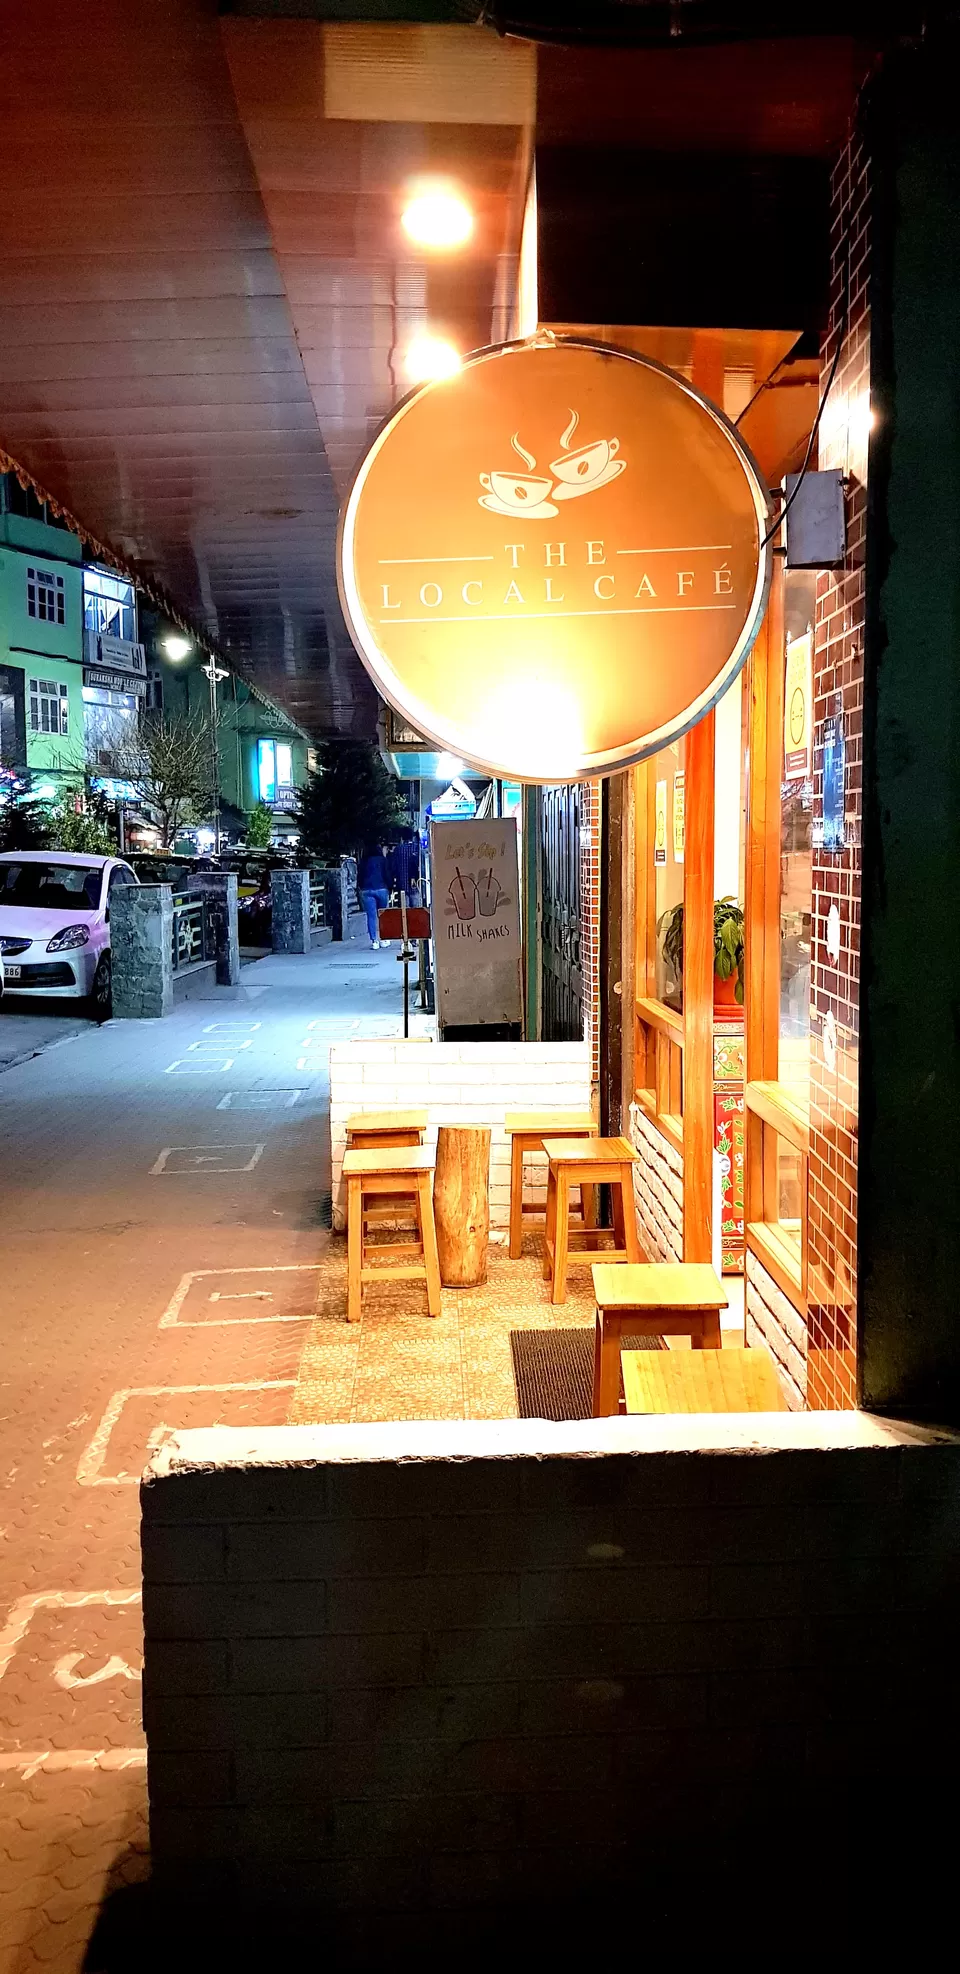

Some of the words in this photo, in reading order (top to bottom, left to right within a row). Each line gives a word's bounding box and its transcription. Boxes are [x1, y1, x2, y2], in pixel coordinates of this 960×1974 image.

[505, 541, 607, 569] THE
[381, 578, 565, 609] LOCAL
[593, 563, 734, 601] CAFÉ
[444, 842, 474, 860] Let's
[448, 922, 473, 940] MILK
[476, 924, 510, 943] SHAKES
